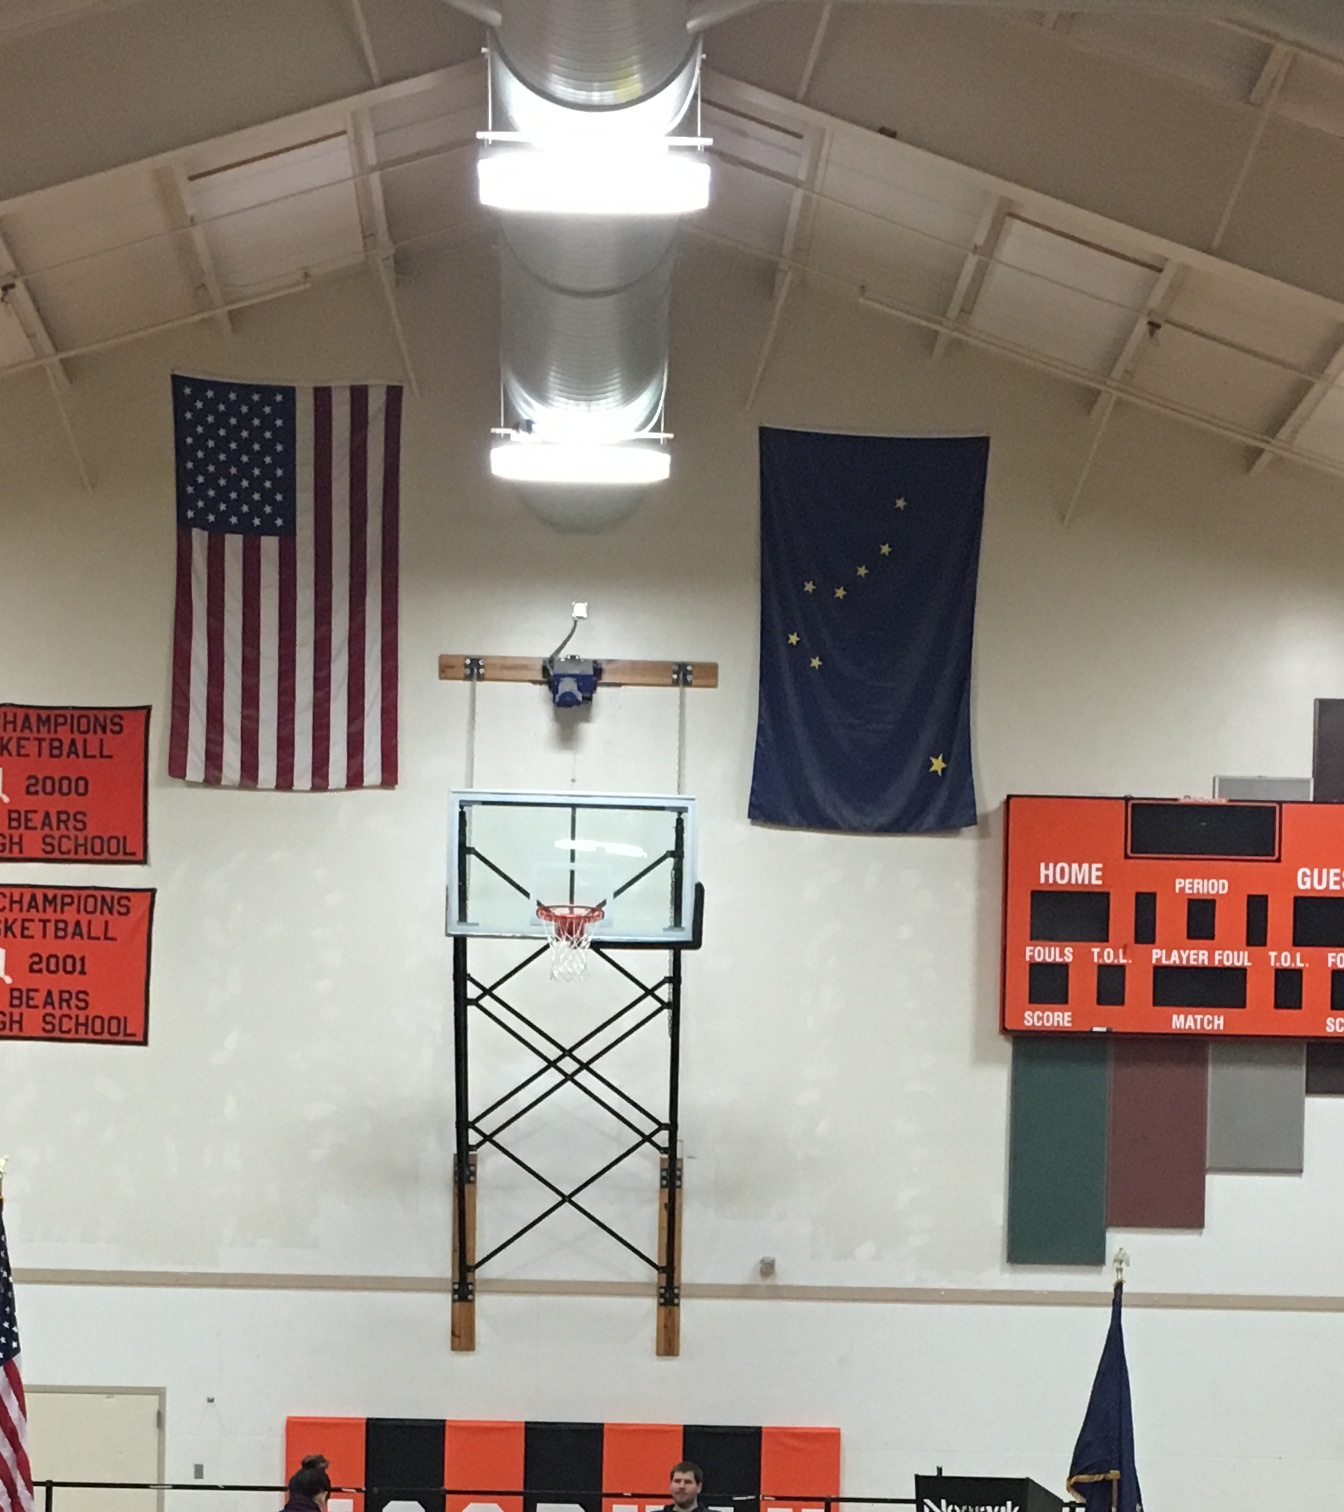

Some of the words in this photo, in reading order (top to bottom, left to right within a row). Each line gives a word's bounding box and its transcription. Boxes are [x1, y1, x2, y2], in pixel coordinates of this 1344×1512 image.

[25, 775, 89, 796] 2000
[8, 810, 87, 831] BEARS
[42, 834, 136, 856] SCHOOL
[1040, 862, 1103, 885] HOME
[1175, 878, 1228, 894] PERIOD
[29, 953, 87, 975] 2001
[1026, 947, 1073, 963] FOULS
[1091, 948, 1132, 963] T.O.L.
[1152, 949, 1209, 965] PLAYER
[1215, 951, 1252, 967] FOUL
[1269, 952, 1309, 968] T.O.L.
[9, 988, 89, 1011] BEARS
[42, 1013, 136, 1037] SCHOOL
[1024, 1011, 1072, 1027] SCORE
[1172, 1014, 1224, 1031] MATCH
